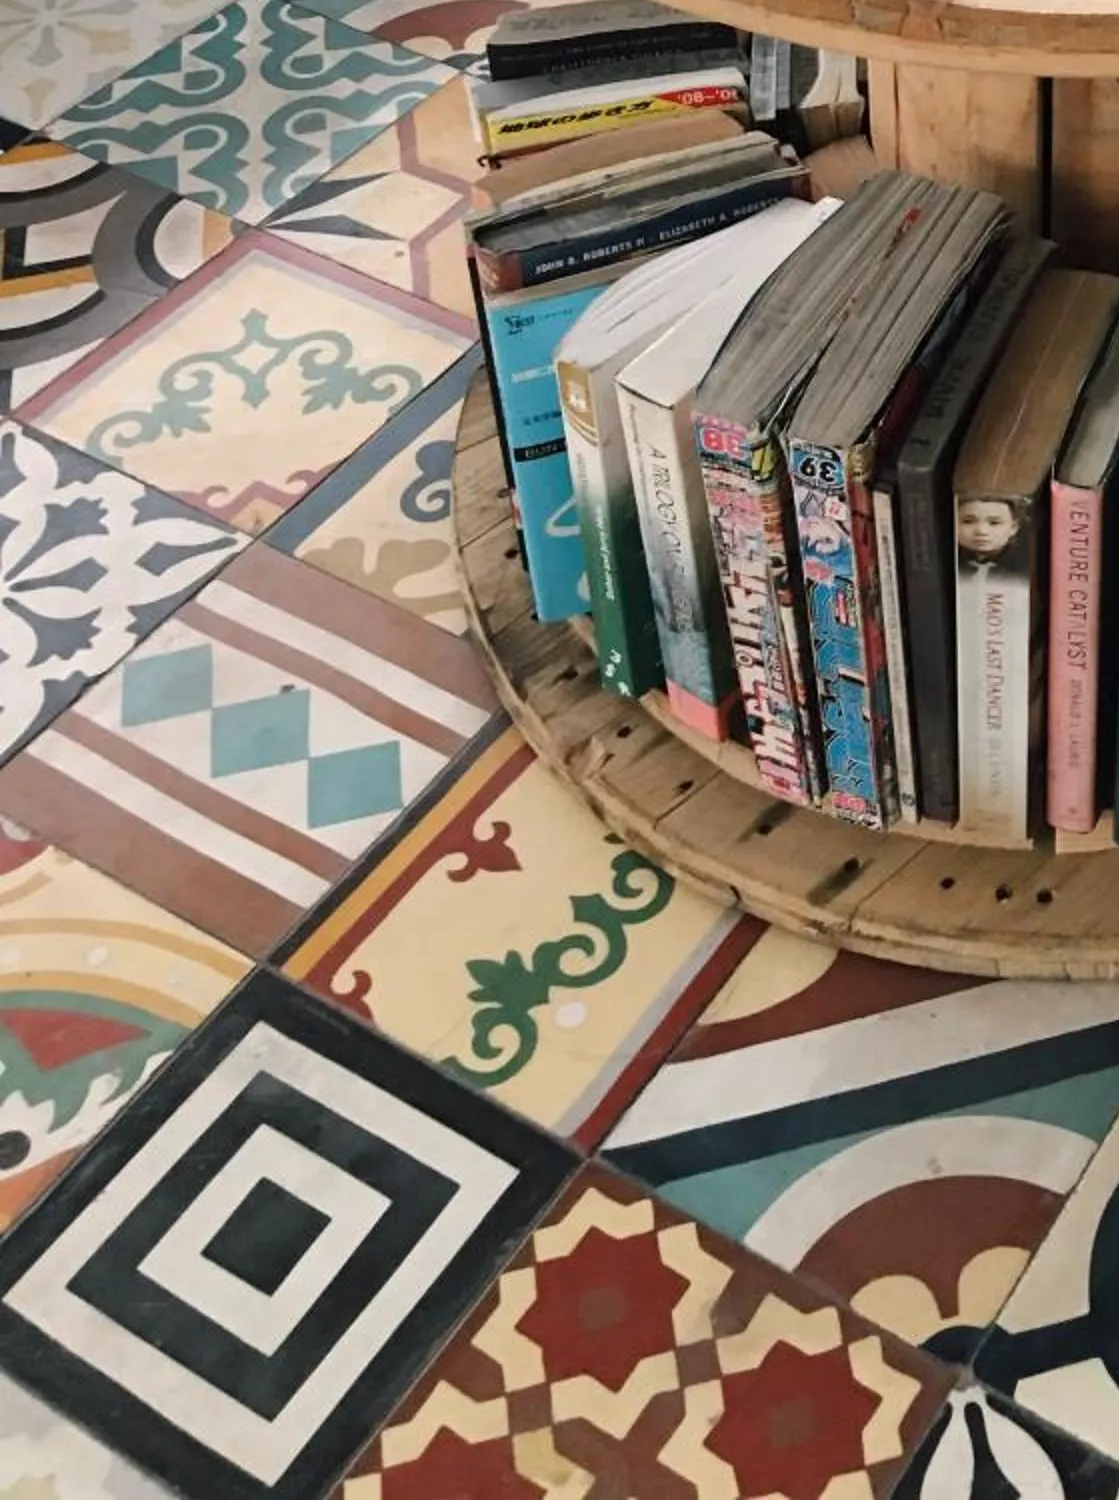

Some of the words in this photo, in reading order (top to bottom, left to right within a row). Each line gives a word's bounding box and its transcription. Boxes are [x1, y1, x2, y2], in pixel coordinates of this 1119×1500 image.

[535, 260, 564, 275] JOHN
[584, 241, 631, 261] ROBERTS
[659, 217, 715, 241] ELIZABETH
[653, 463, 677, 526] TRILOGY
[799, 456, 837, 484] 39
[1068, 500, 1090, 582] VENTURE
[986, 639, 1004, 670] LAST
[1066, 590, 1088, 671] CATALYST
[986, 672, 1004, 731] DANCER
